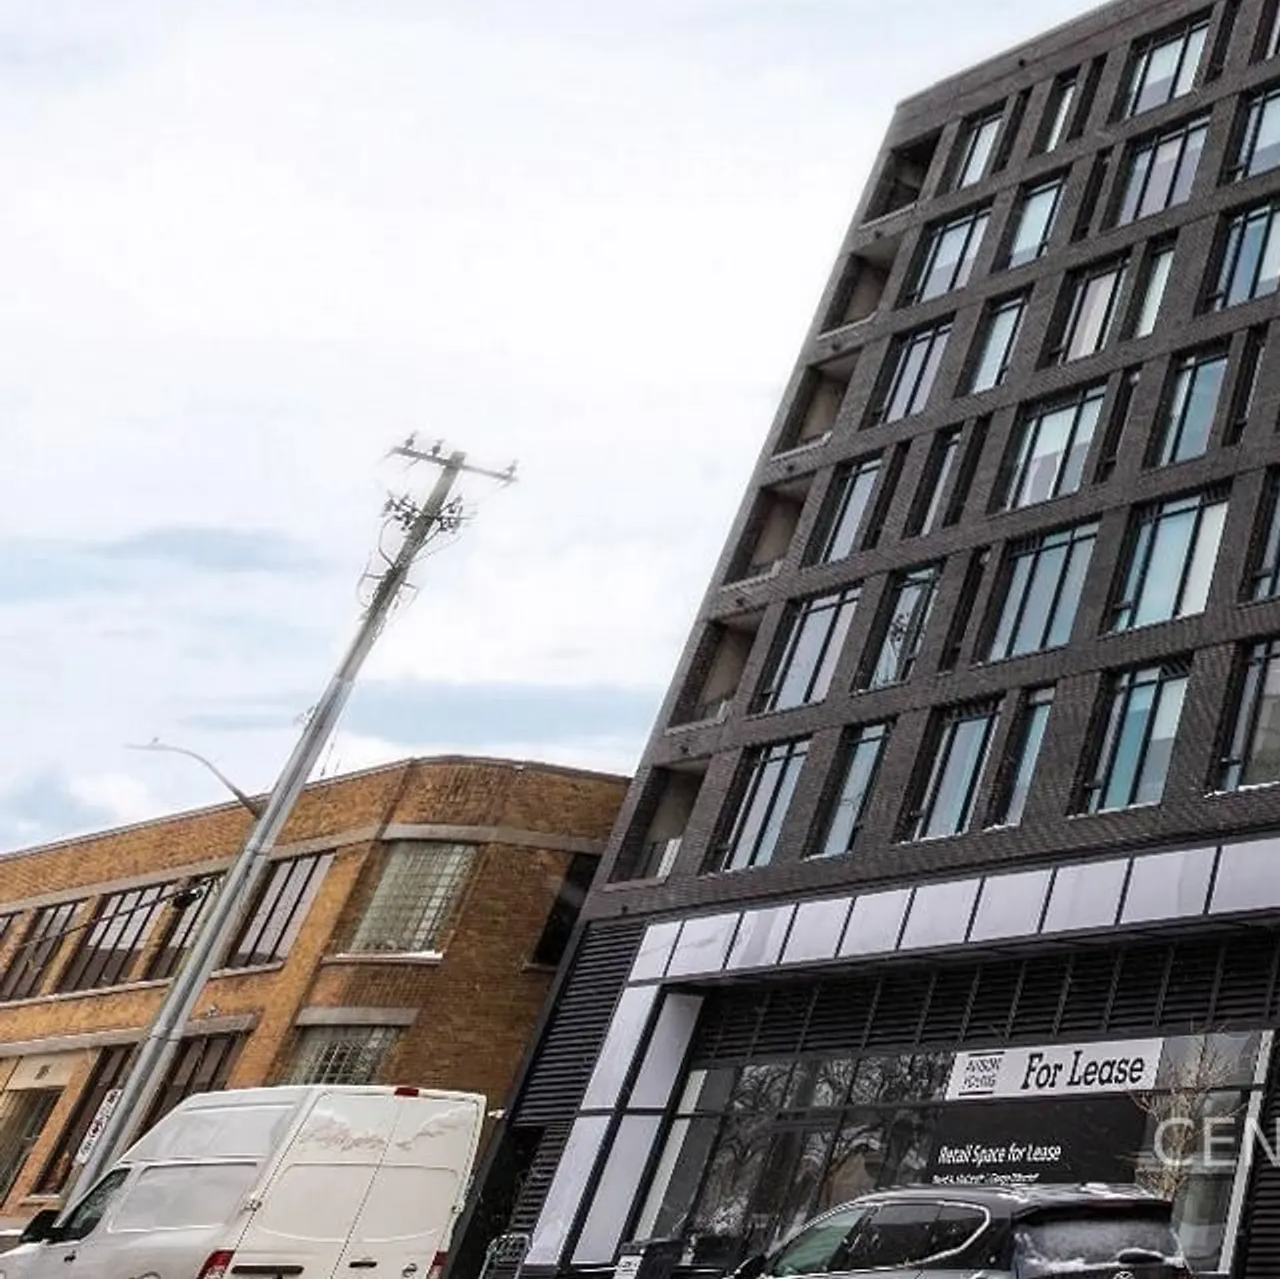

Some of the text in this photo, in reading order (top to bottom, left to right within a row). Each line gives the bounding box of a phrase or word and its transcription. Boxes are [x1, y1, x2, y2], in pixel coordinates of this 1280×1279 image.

[1021, 1050, 1145, 1090] For Lease
[972, 1145, 1006, 1168] Space
[1007, 1142, 1026, 1162] for
[1027, 1144, 1061, 1161] Lease
